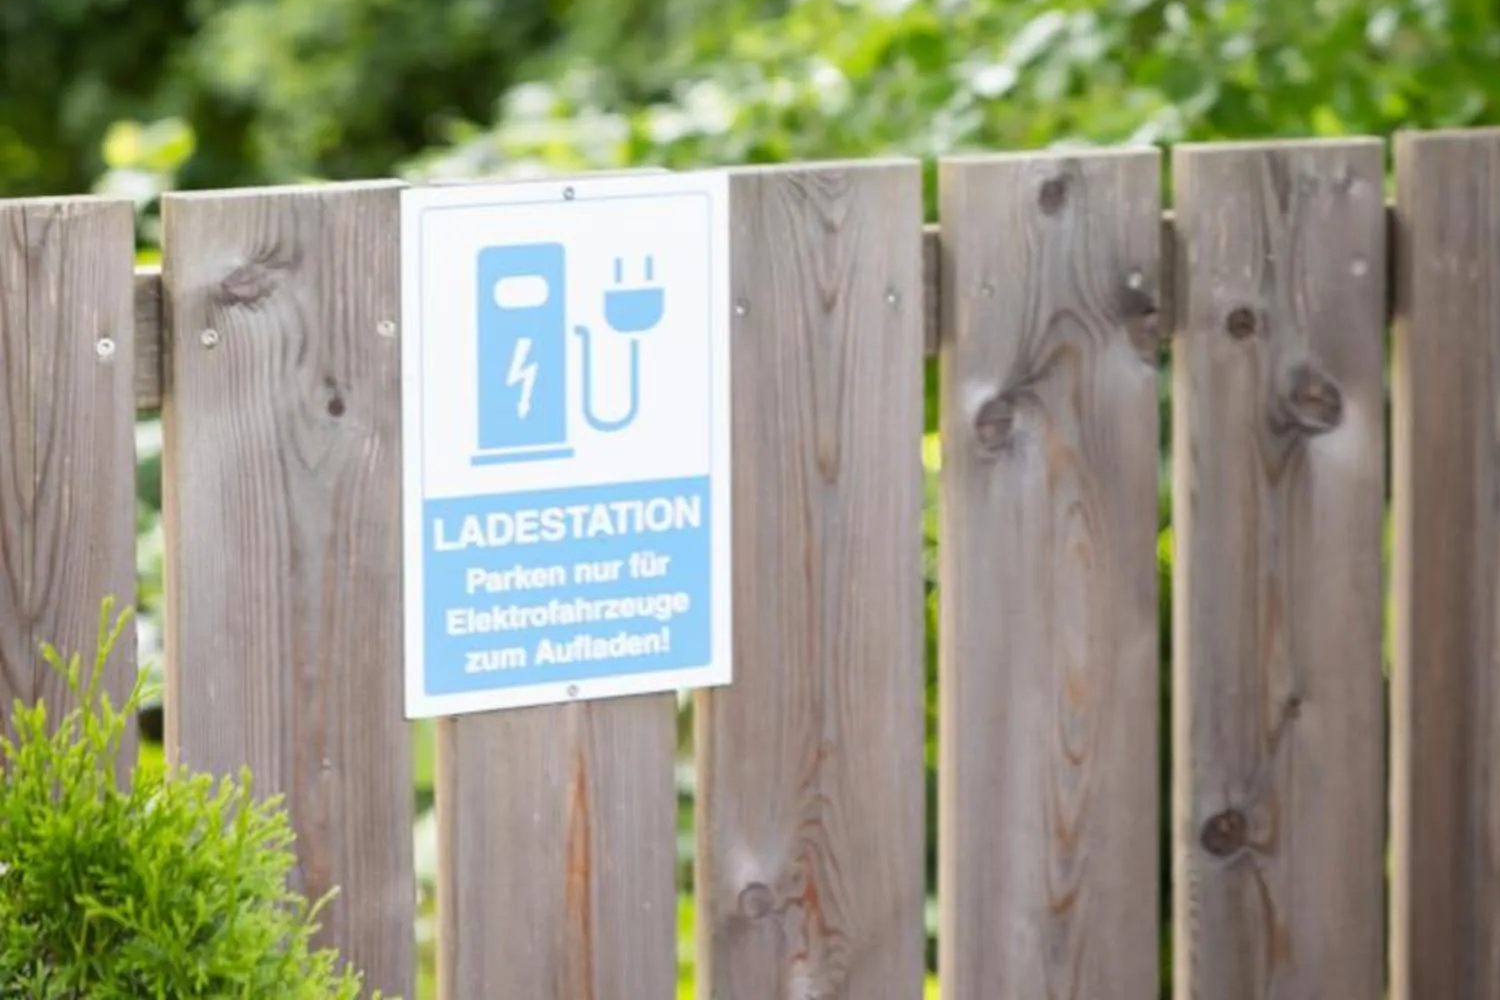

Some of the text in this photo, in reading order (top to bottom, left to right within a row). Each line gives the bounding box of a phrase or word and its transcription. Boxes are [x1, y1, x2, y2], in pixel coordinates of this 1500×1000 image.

[433, 495, 701, 551] LADESTATION
[467, 550, 670, 594] Parken nur für
[447, 591, 690, 636] Elektrofahrzeuge
[465, 627, 670, 674] zum Aufladen!
